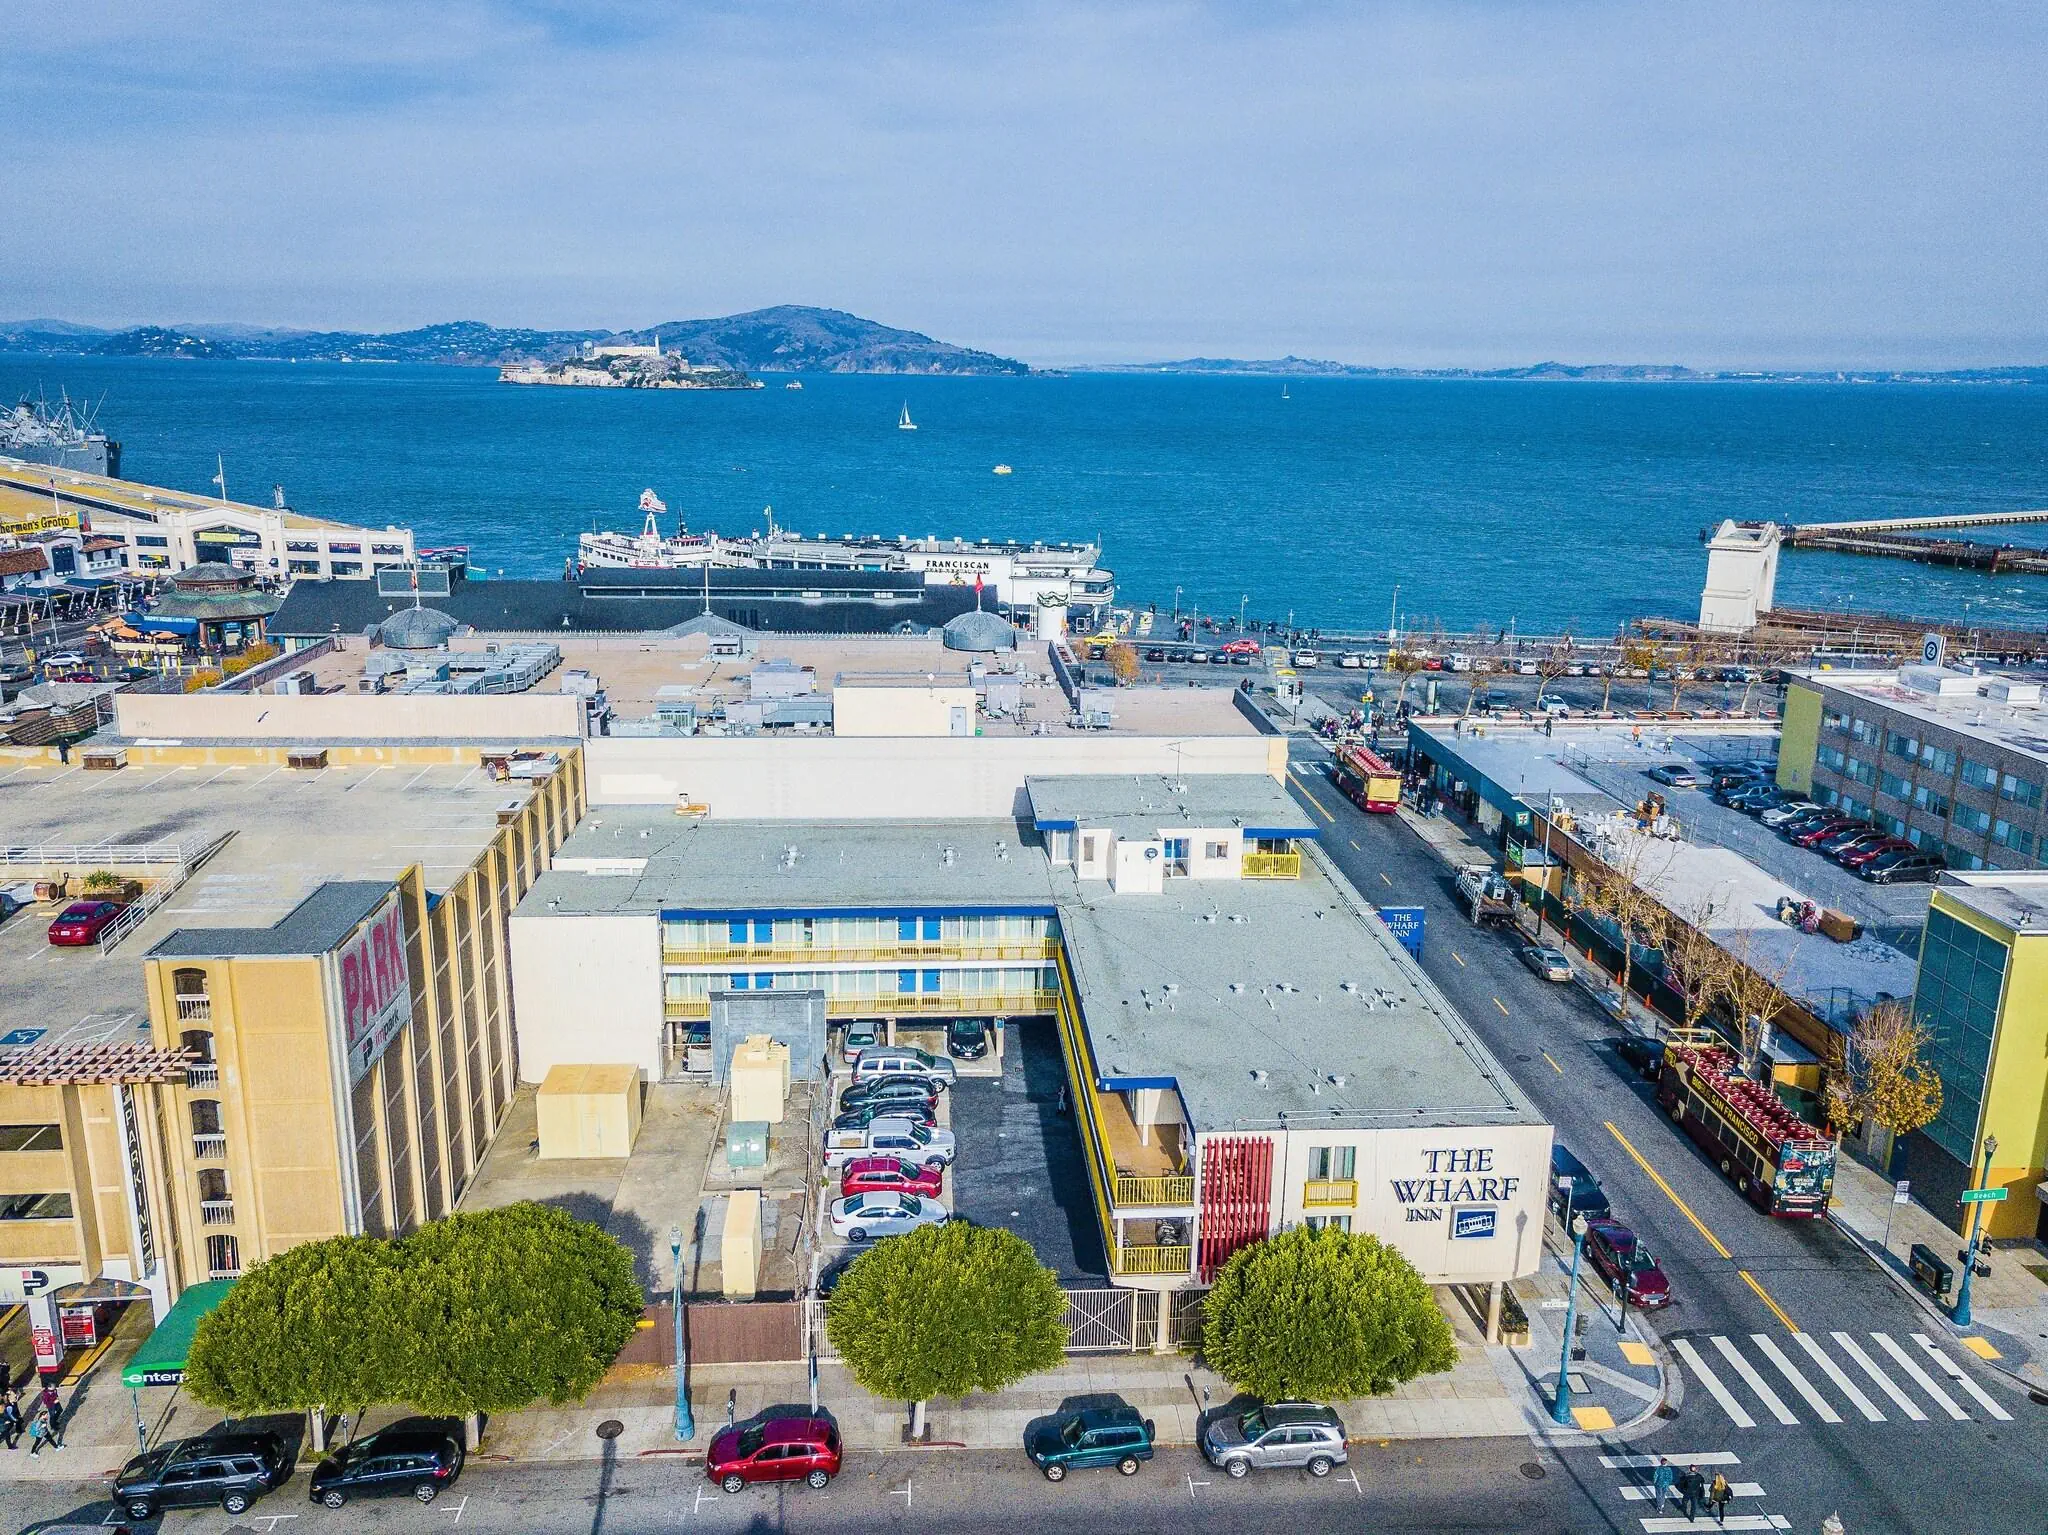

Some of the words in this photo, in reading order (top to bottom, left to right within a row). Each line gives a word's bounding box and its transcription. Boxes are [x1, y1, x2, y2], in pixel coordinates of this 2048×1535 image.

[40, 516, 70, 529] Grotto
[926, 560, 989, 569] FRANCISCAN
[1386, 921, 1419, 930] WHARF
[1393, 913, 1412, 922] THE
[1392, 929, 1410, 938] INN
[343, 905, 405, 1042] PARK
[374, 1008, 400, 1048] impark
[1711, 1095, 1725, 1112] SAN
[1724, 1106, 1759, 1145] FRANCISCO
[1422, 1148, 1494, 1173] THE
[123, 1108, 151, 1248] PARKING
[1391, 1177, 1520, 1203] WHARF
[1406, 1208, 1443, 1222] INN
